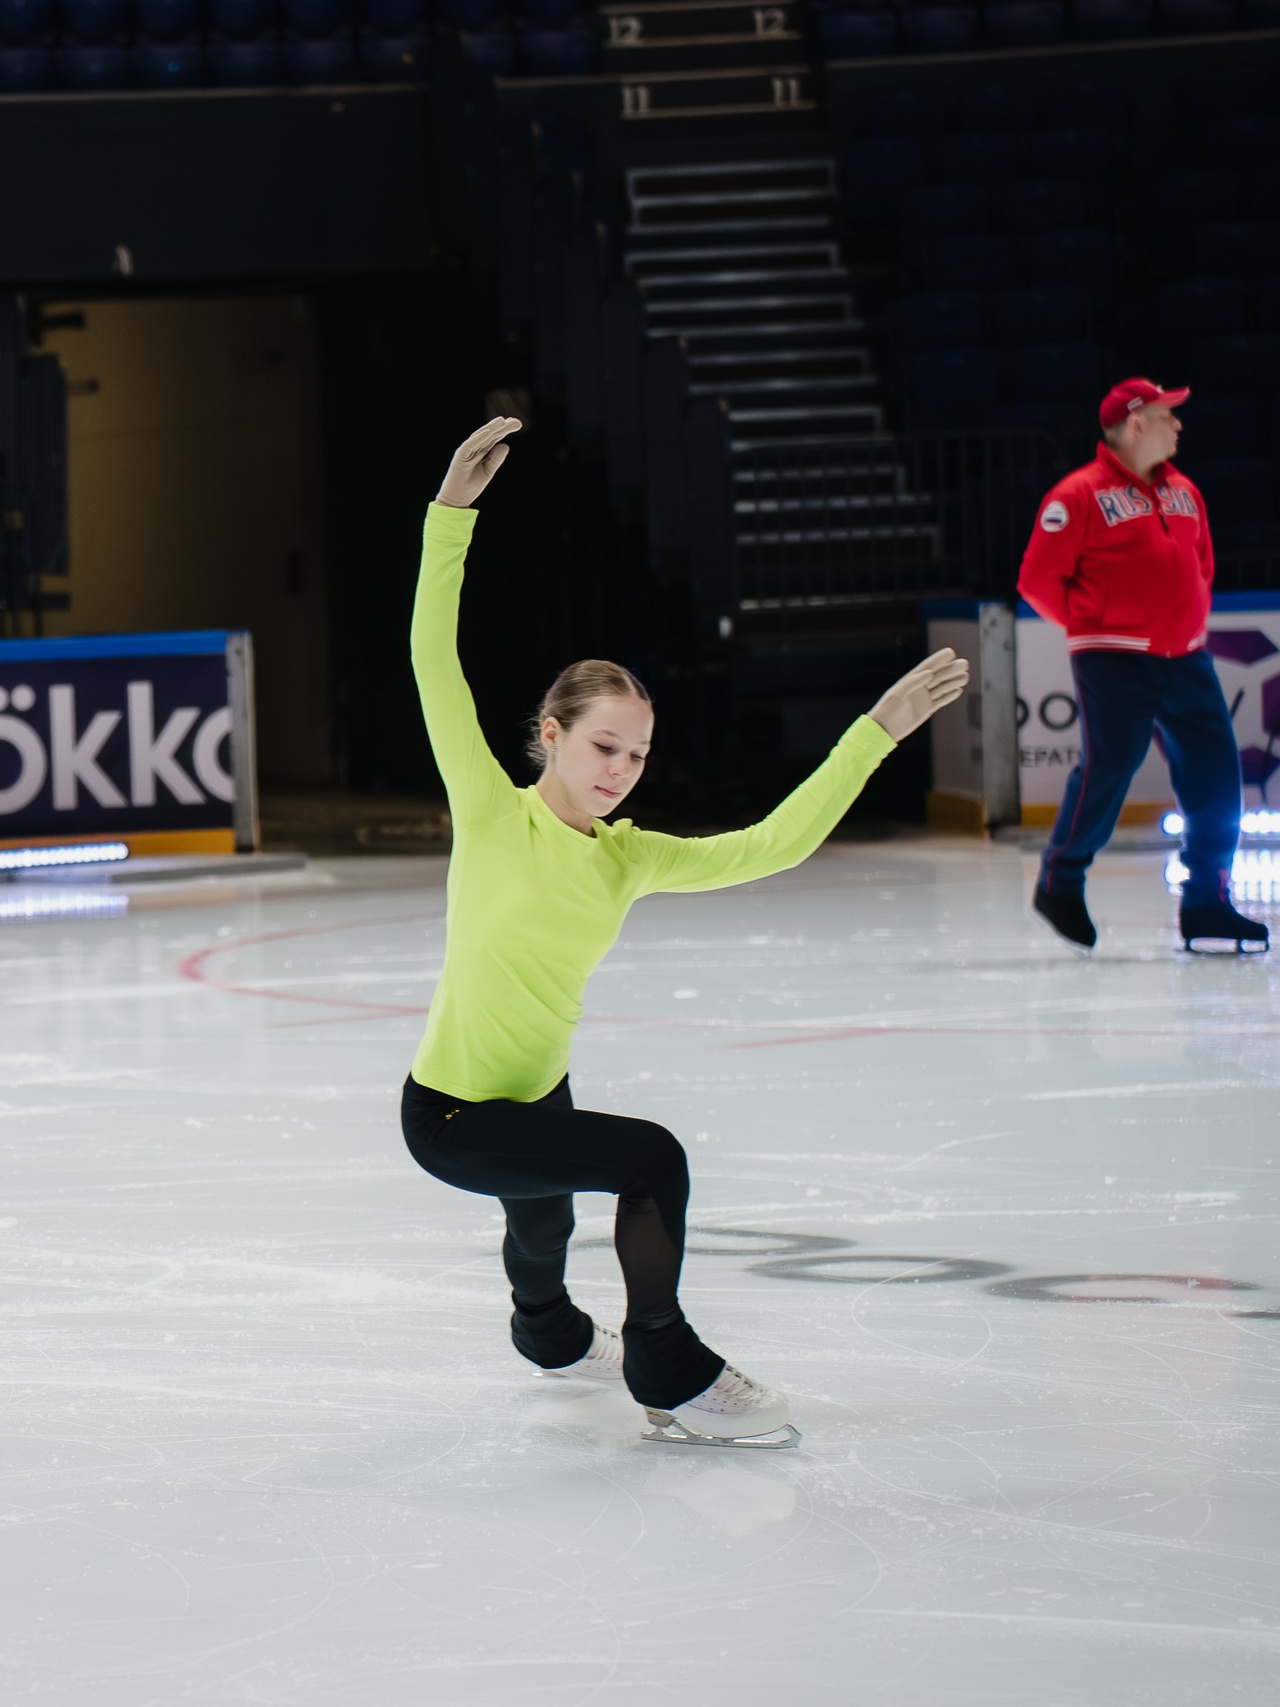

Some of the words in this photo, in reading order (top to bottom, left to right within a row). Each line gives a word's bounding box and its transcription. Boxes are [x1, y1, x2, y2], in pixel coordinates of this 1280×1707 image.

[609, 17, 643, 45] 12
[754, 9, 787, 38] 12
[623, 85, 650, 117] 11
[773, 77, 800, 109] 11
[1095, 480, 1199, 527] RUSSIA
